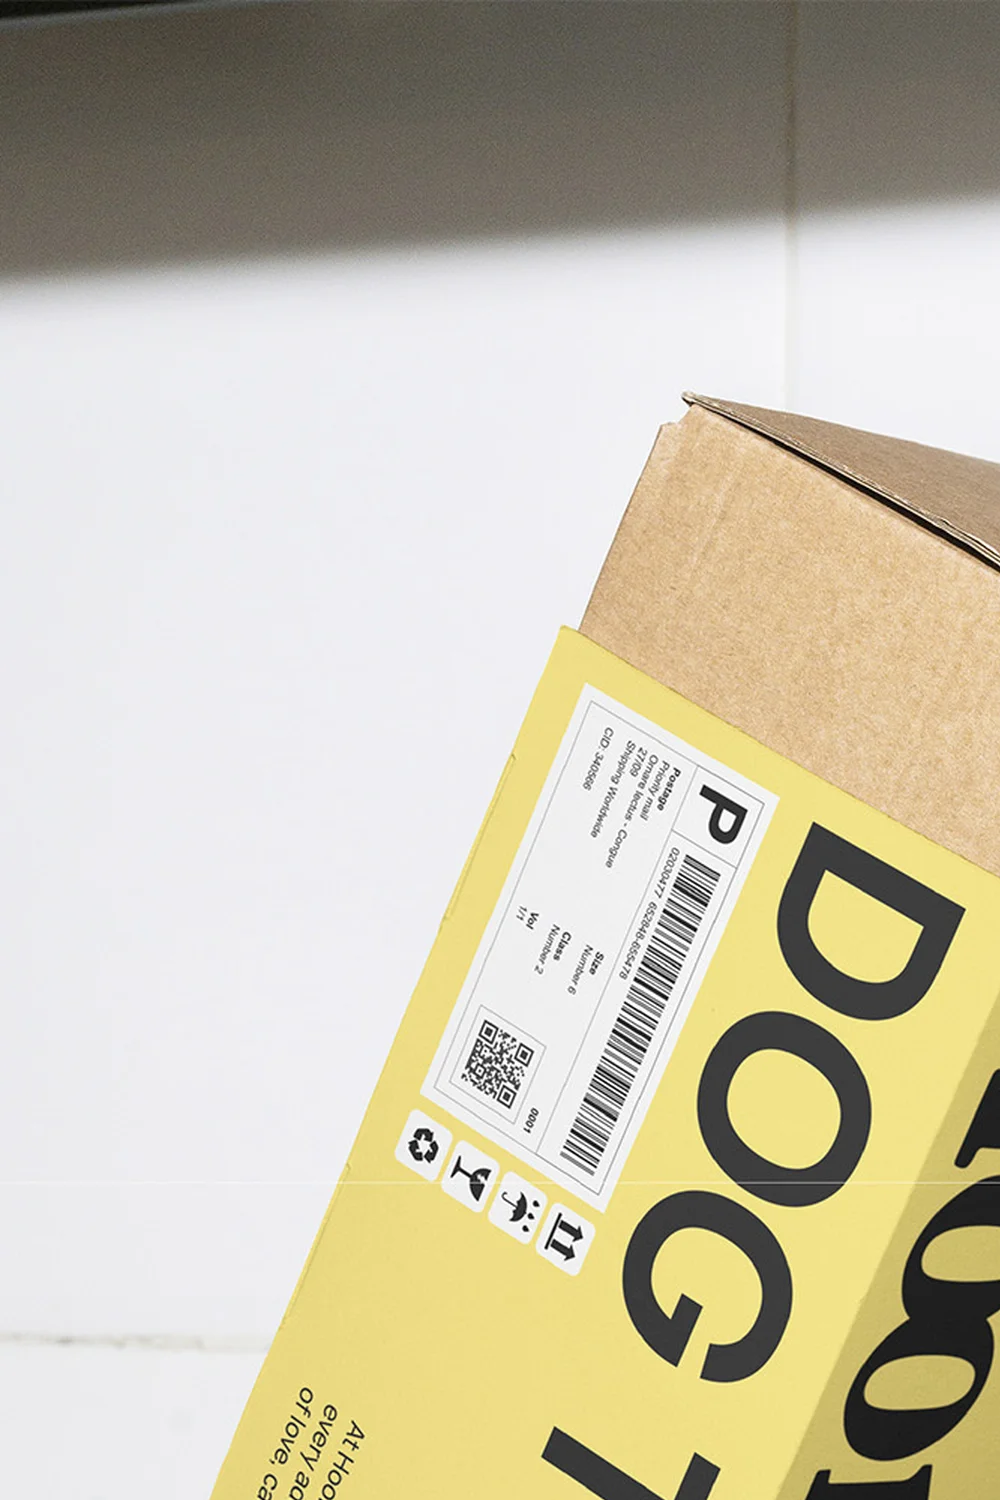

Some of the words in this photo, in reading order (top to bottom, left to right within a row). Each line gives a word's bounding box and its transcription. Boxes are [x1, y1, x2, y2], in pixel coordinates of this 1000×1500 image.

[598, 727, 614, 751] CID:
[582, 751, 604, 791] 340566
[610, 740, 637, 785] Shipping
[629, 746, 648, 778] 27/09
[637, 754, 659, 790] Ornare
[647, 760, 671, 797] Priority
[624, 790, 644, 821] lectus
[656, 767, 682, 811] Postage
[590, 786, 618, 838] Worldwide
[639, 796, 654, 821] mail
[699, 784, 748, 845] P
[605, 828, 628, 869] Congue
[515, 905, 528, 921] 1/1
[525, 912, 540, 930] Vol
[538, 923, 561, 965] Number
[553, 931, 572, 961] Class
[534, 964, 544, 975] 2
[571, 944, 594, 986] Number
[589, 951, 605, 975] Size
[567, 985, 577, 995] 6
[621, 821, 967, 1383] DOG
[523, 1107, 540, 1134] 0001
[295, 1387, 314, 1419] of
[269, 1414, 307, 1465] love,
[299, 1404, 338, 1472] every
[341, 1420, 365, 1452] At
